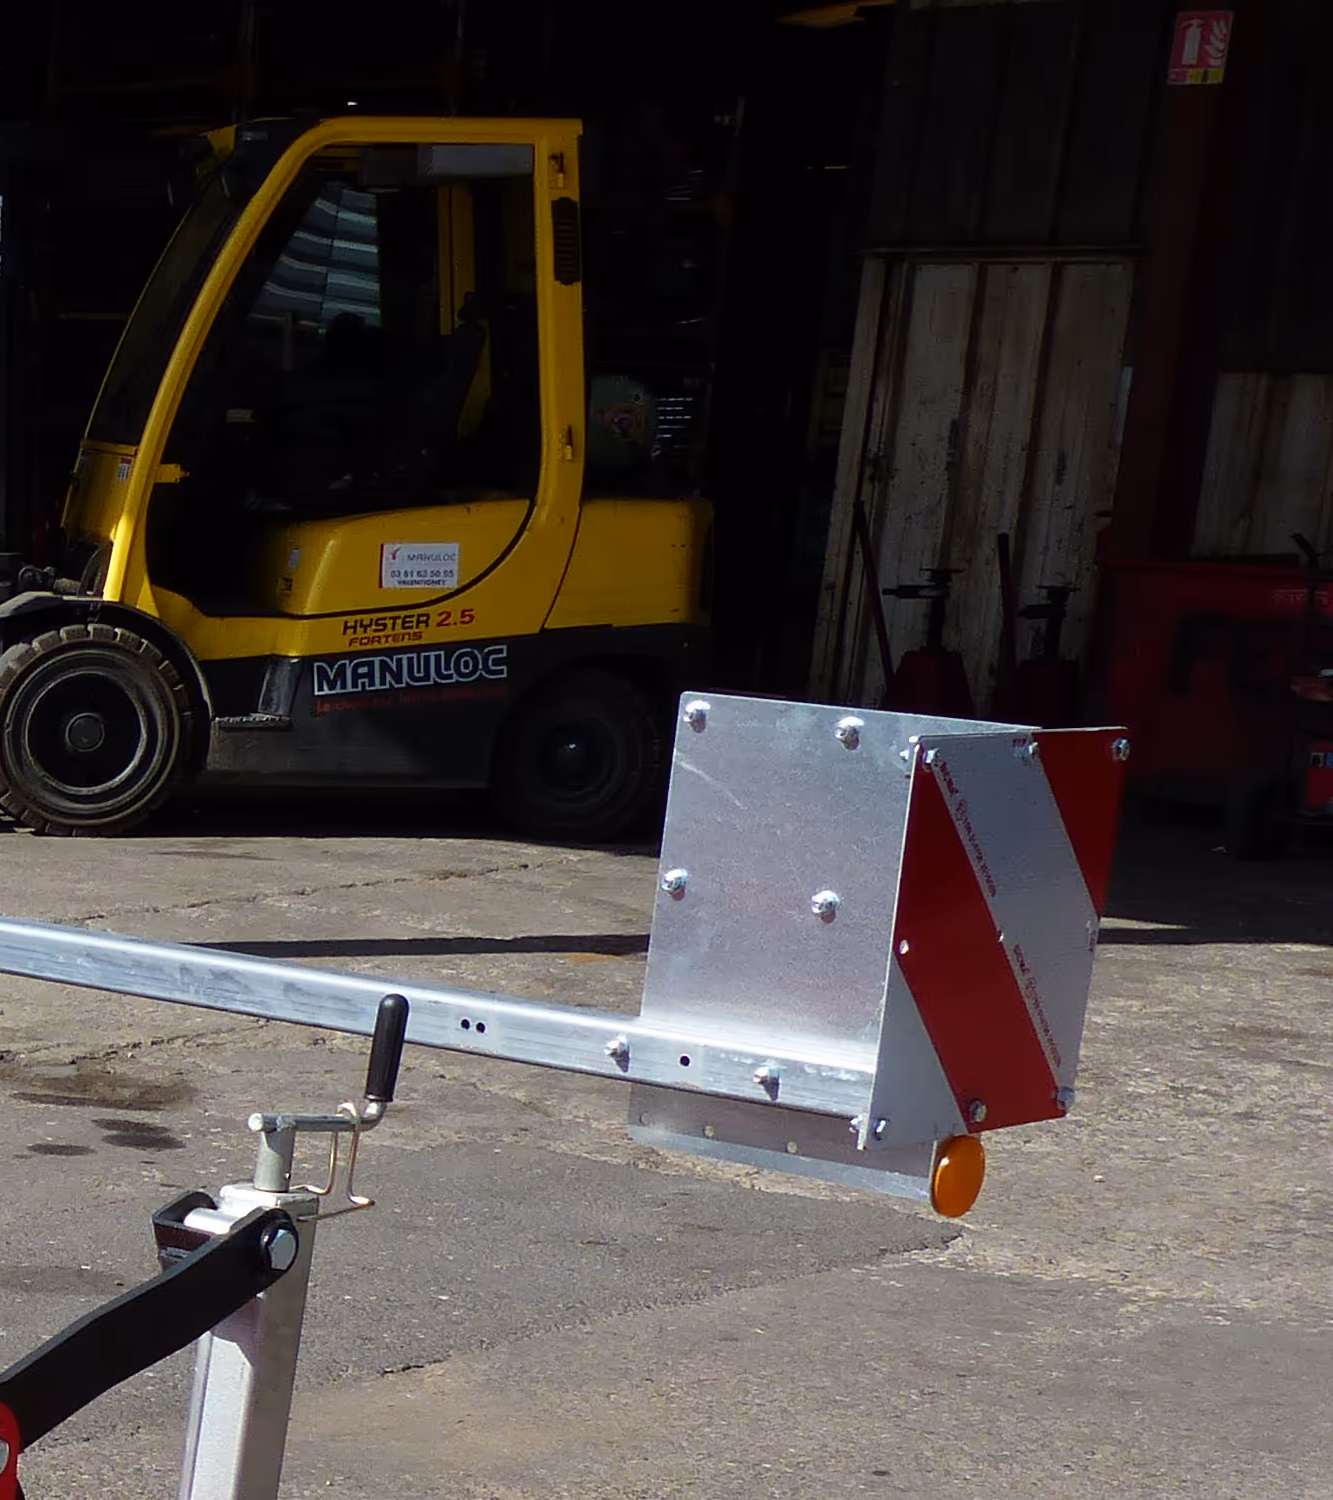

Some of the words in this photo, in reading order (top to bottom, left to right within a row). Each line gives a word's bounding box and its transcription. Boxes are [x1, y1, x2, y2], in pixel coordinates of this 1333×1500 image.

[342, 612, 430, 636] HYSTER
[436, 608, 475, 628] 2.5
[349, 631, 423, 647] FORTENS
[313, 644, 508, 696] MANULOC
